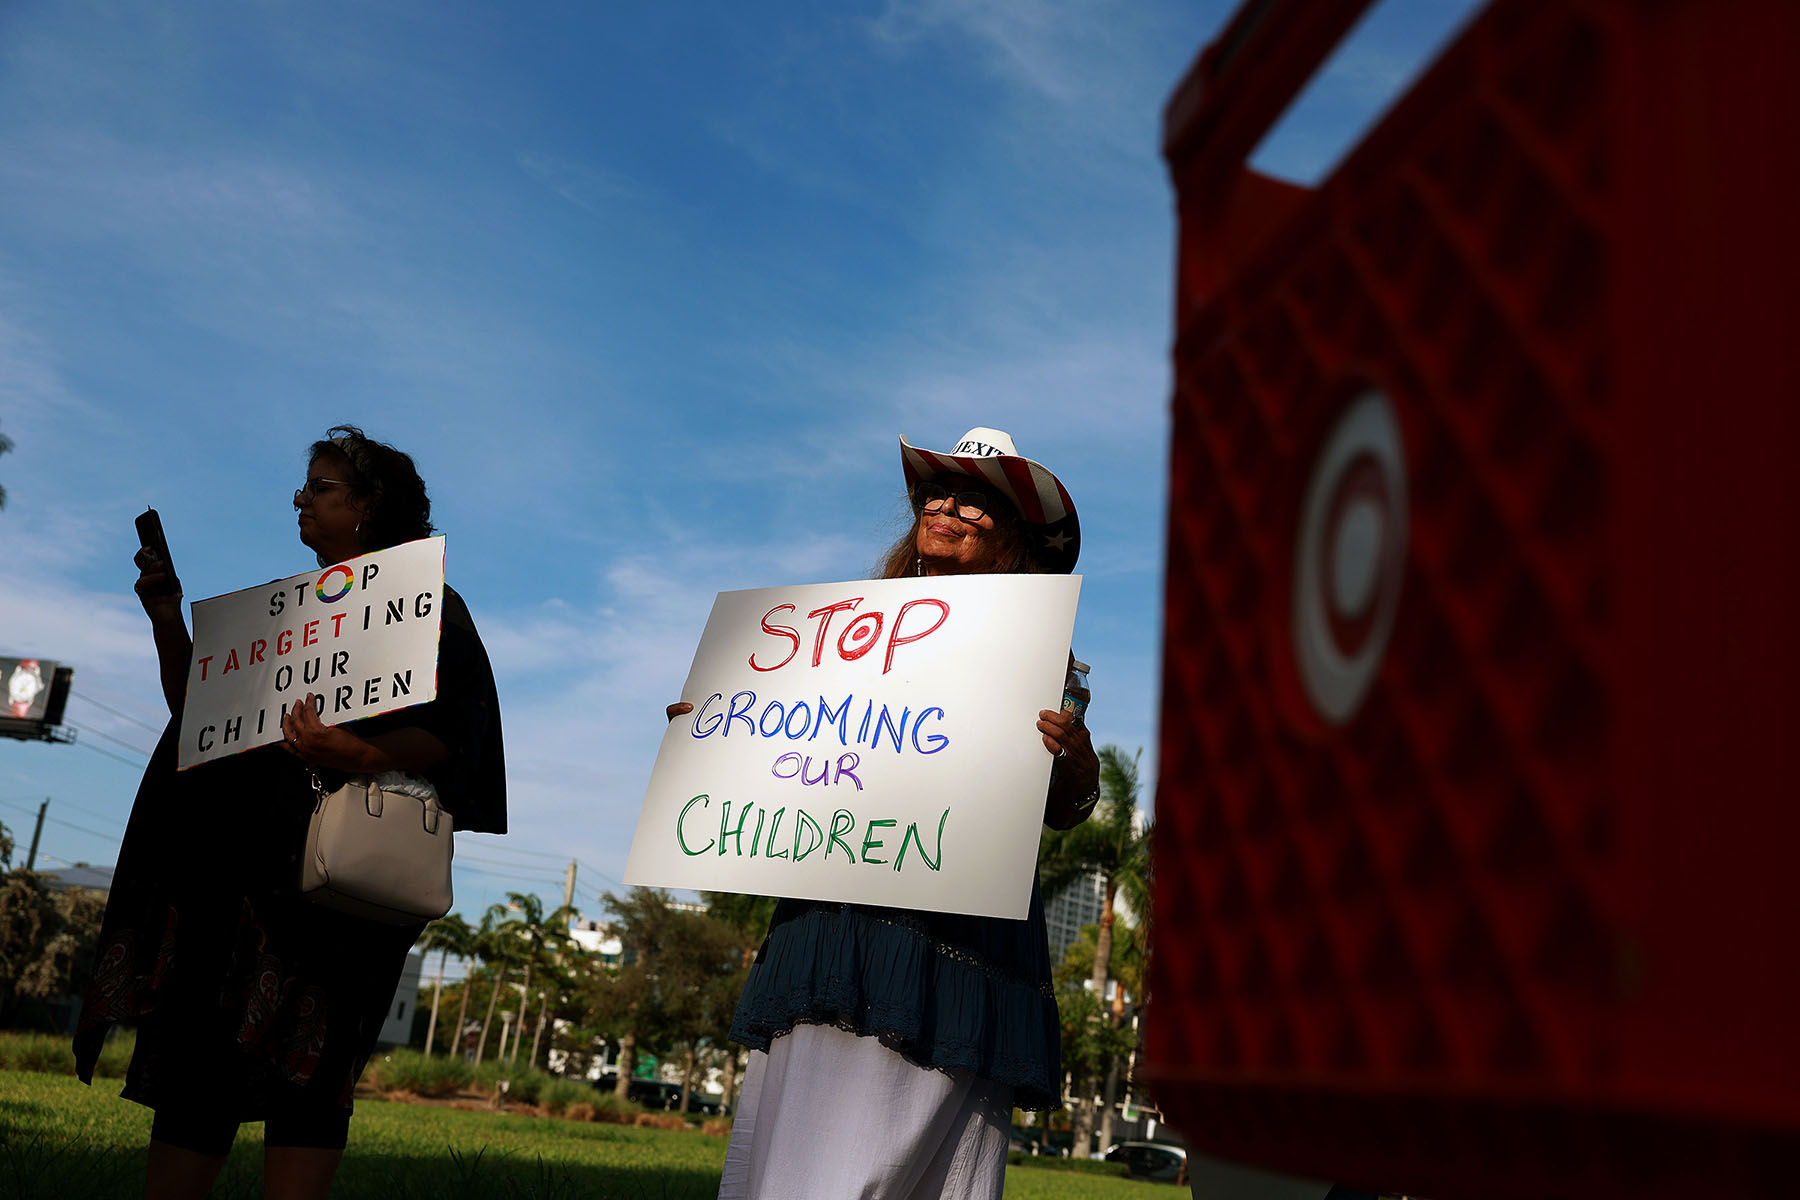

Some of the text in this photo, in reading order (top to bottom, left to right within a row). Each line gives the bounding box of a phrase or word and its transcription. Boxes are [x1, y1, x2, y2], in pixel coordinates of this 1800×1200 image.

[269, 564, 379, 617] STOP
[198, 592, 432, 682] TARGETING
[748, 598, 950, 675] STOP
[275, 651, 350, 692] OUR
[690, 690, 949, 754] GROOMING
[772, 752, 864, 792] OUR
[676, 794, 950, 872] CHILDREN
